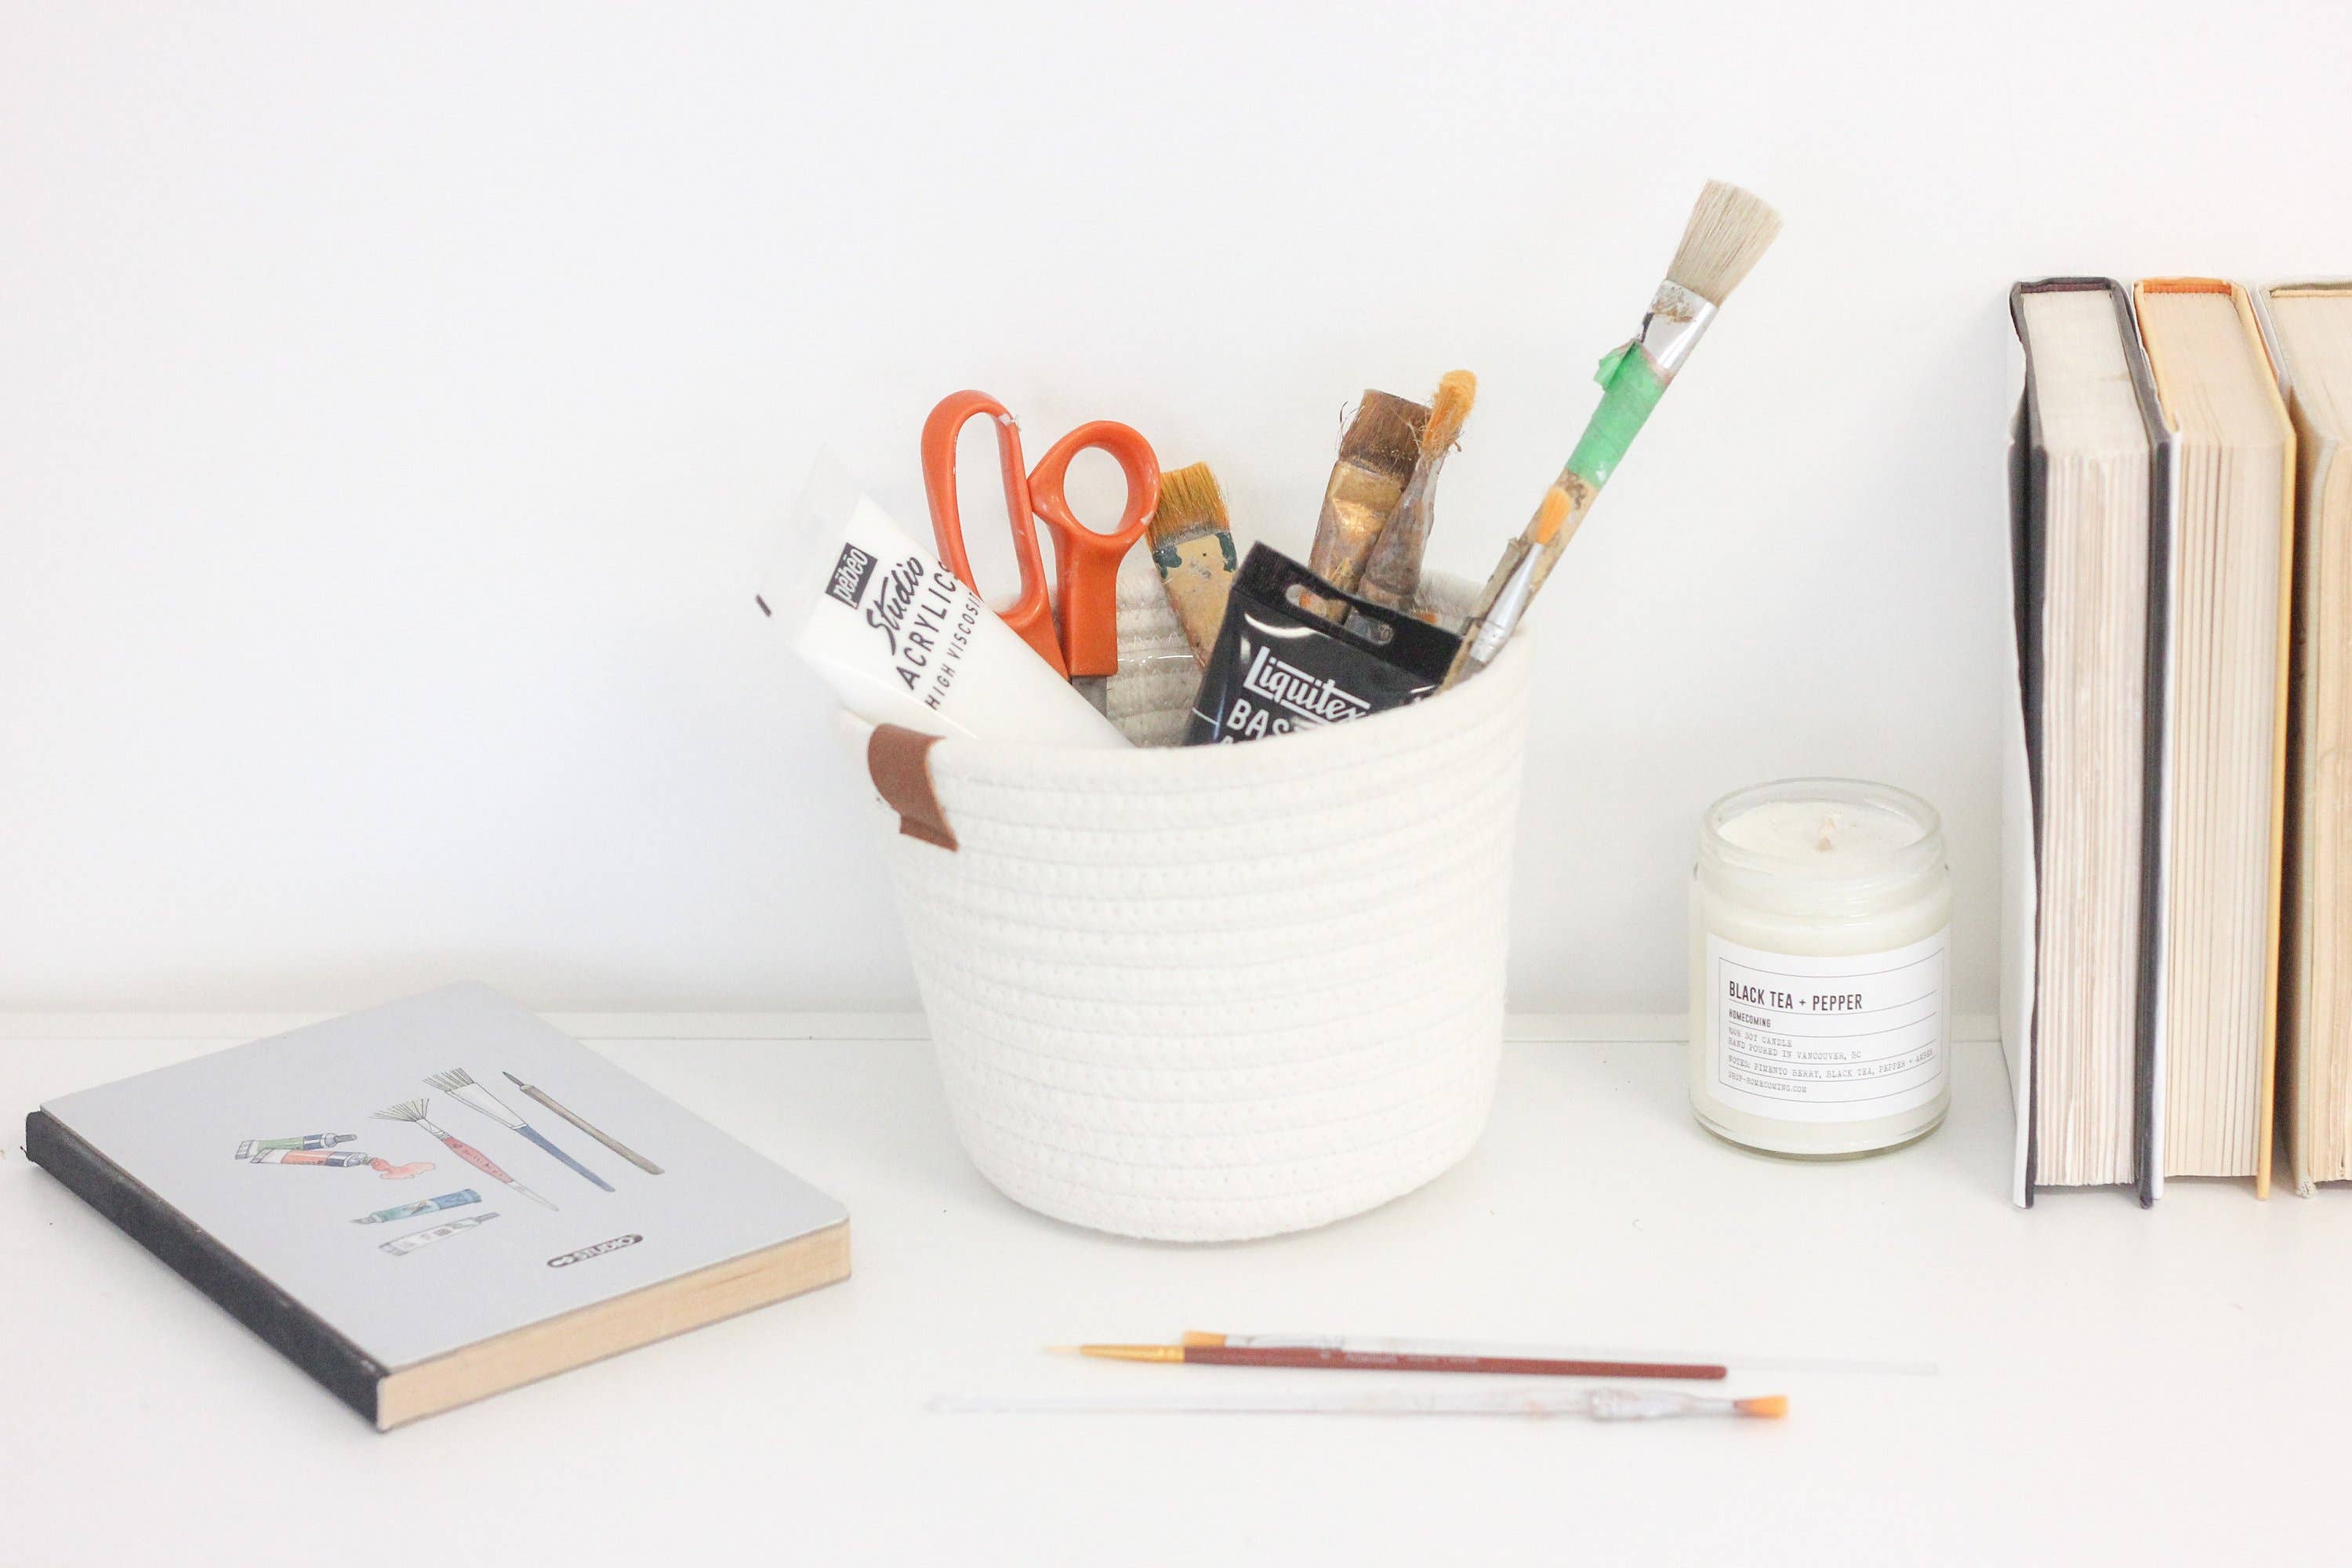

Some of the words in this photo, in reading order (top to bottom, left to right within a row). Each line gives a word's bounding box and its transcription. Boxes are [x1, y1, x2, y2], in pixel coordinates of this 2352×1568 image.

[866, 557, 924, 655] Studio
[924, 664, 956, 710] HIGH
[1730, 981, 1765, 1005] BLACK
[1770, 991, 1793, 1009] TEA
[1813, 994, 1863, 1011] PEPPER
[1729, 1008, 1771, 1028] HOMECOMING
[1728, 1037, 1745, 1049] HAND
[1749, 1044, 1778, 1056] POURED
[1782, 1050, 1792, 1058] IN
[1762, 1036, 1792, 1047] CANDLE
[1754, 1062, 1788, 1076] PIMENTO
[1826, 1069, 1852, 1079] BLACK
[1857, 1068, 1875, 1076] TEA,
[1878, 1060, 1906, 1073] PEPPER
